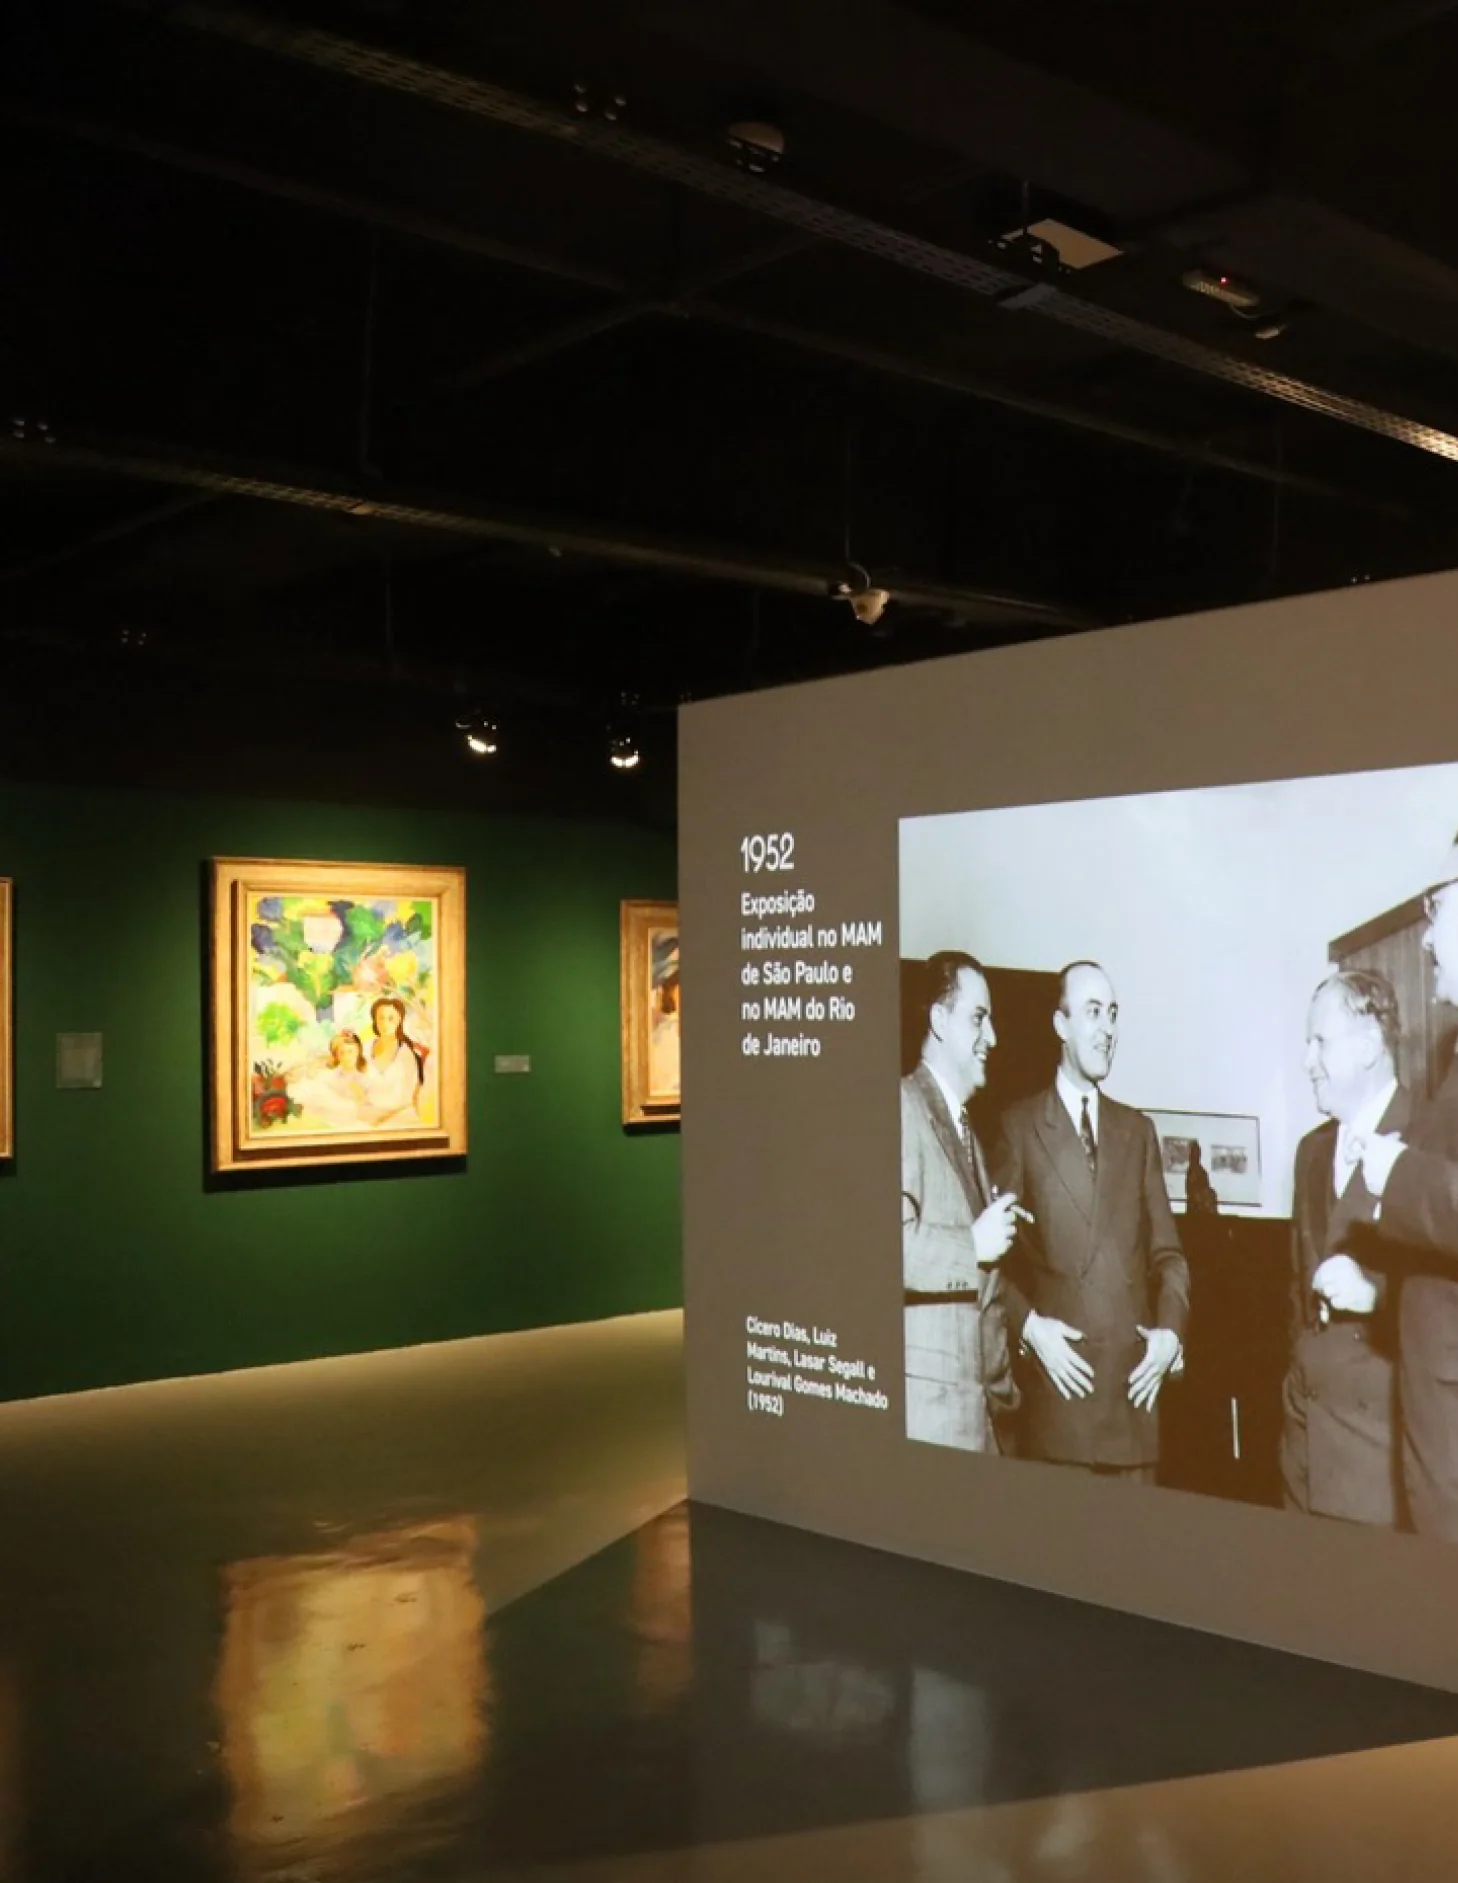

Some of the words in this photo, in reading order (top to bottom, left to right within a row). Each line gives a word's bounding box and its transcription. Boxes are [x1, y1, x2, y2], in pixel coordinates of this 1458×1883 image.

[741, 832, 794, 873] 1952
[741, 889, 815, 920] Exposição
[741, 924, 814, 950] individual
[818, 928, 837, 948] no
[841, 920, 882, 947] MAM
[741, 962, 759, 985] de
[763, 961, 790, 985] São
[795, 960, 839, 985] Paulo
[842, 965, 853, 984] e
[742, 1002, 760, 1020] no
[764, 996, 801, 1021] MAM
[805, 996, 825, 1021] do
[830, 995, 856, 1021] Rio
[742, 1033, 760, 1056] de
[763, 1032, 821, 1057] Janeiro
[812, 1326, 838, 1347] Luiz
[793, 1348, 826, 1370] Lasar
[828, 1354, 866, 1381] Segall
[867, 1364, 876, 1381] e
[747, 1366, 793, 1391] Lourival
[793, 1374, 833, 1399] Gomes
[834, 1382, 889, 1410] Machado
[747, 1389, 784, 1416] (1952)
